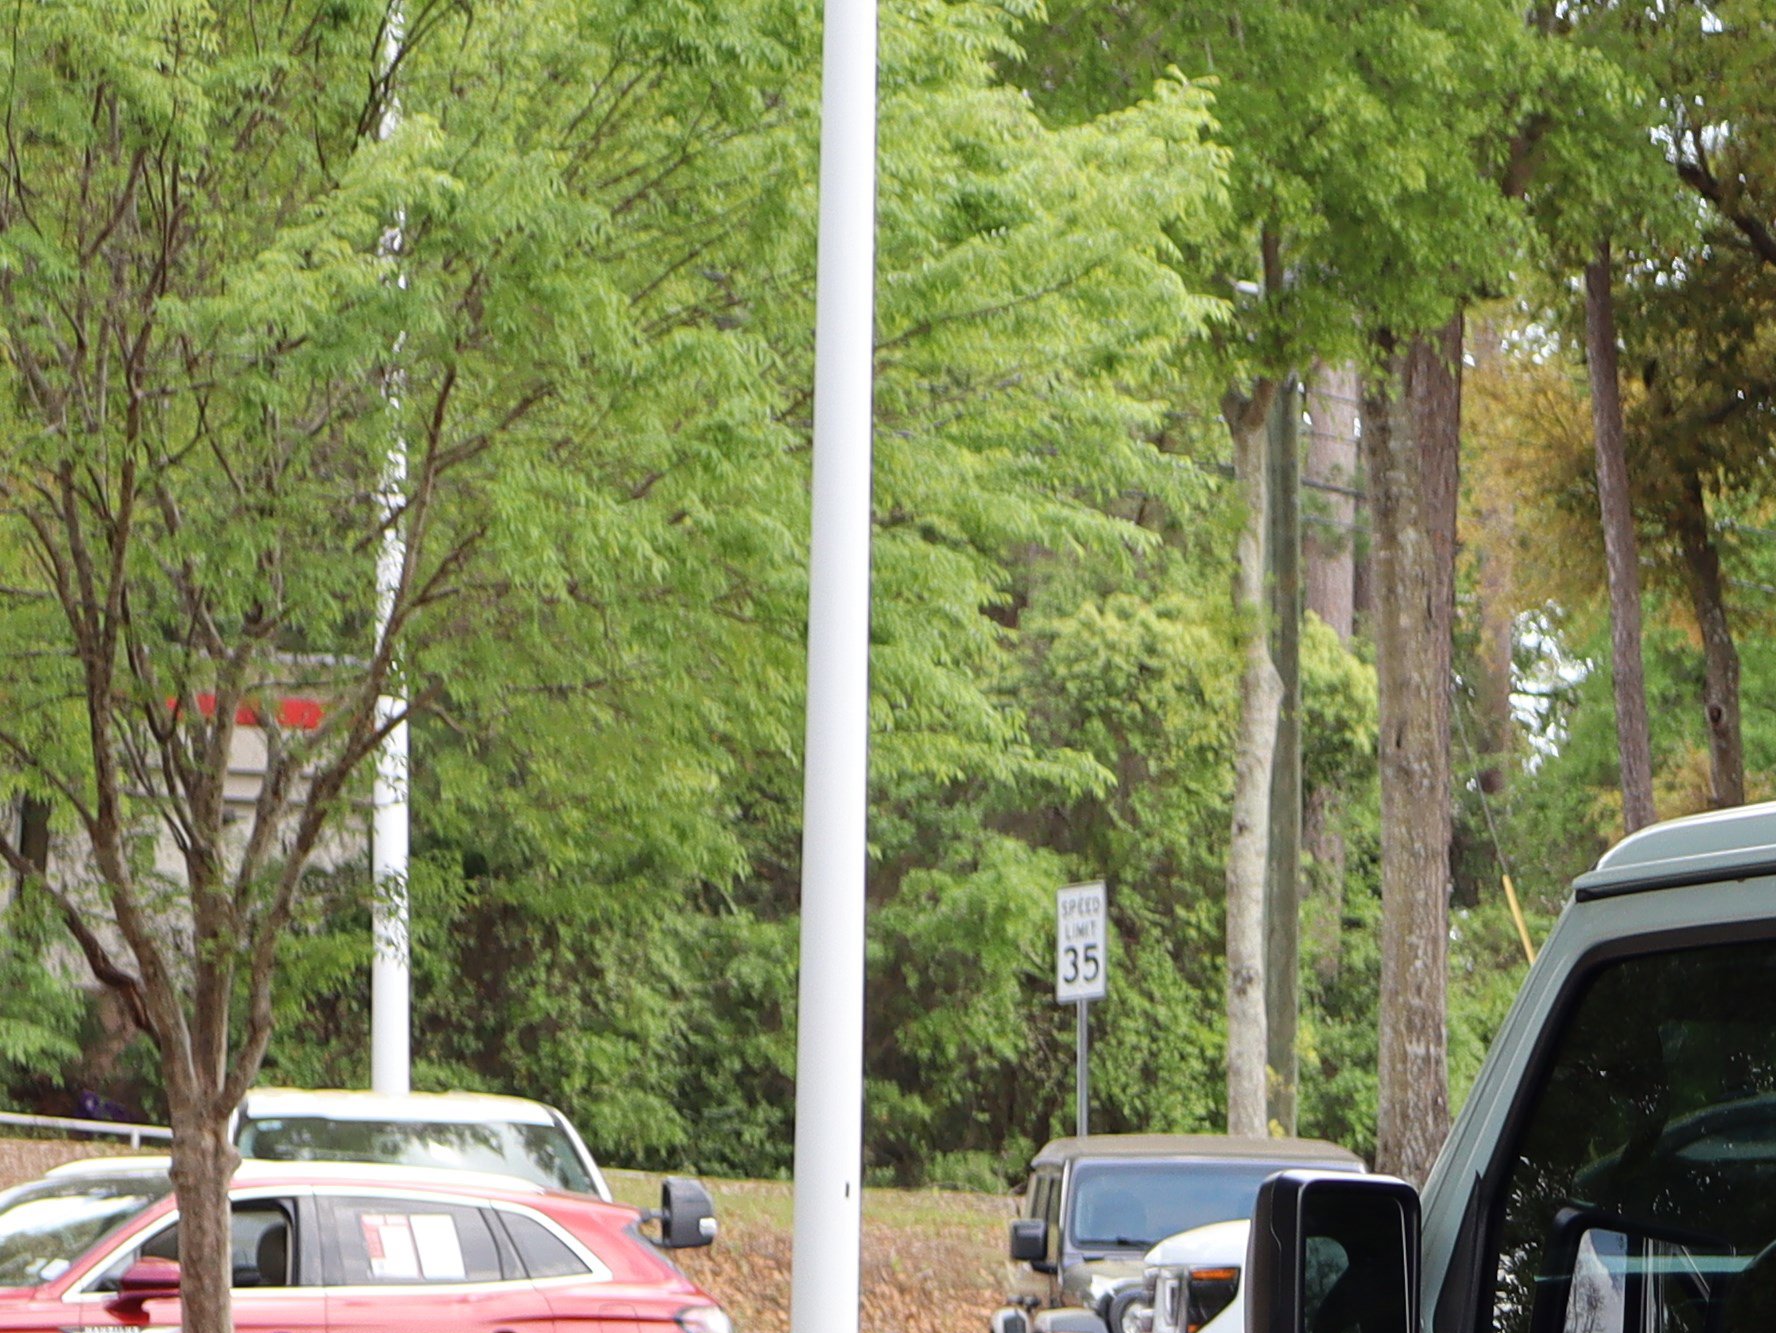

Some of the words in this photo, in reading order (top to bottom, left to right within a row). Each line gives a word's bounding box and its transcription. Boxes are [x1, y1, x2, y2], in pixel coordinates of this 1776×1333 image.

[1062, 895, 1100, 917] SPEED
[1064, 920, 1095, 940] LIMIT
[1063, 943, 1099, 984] 35
